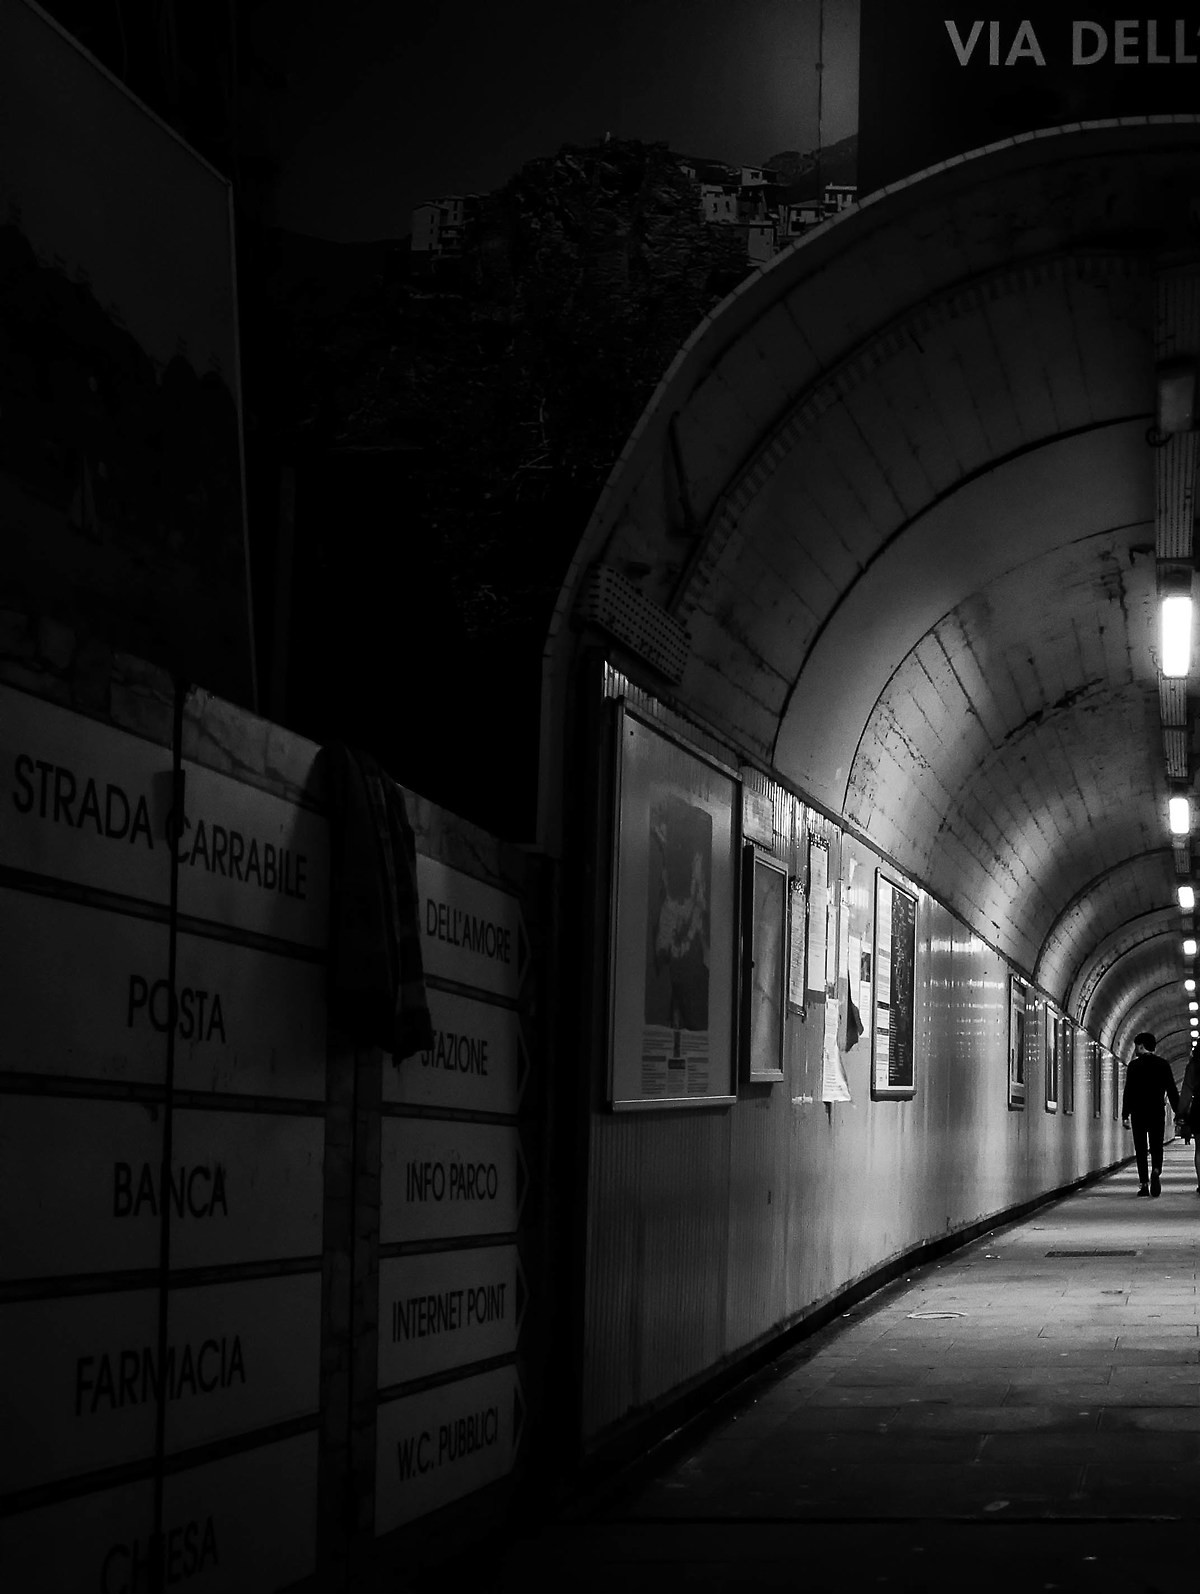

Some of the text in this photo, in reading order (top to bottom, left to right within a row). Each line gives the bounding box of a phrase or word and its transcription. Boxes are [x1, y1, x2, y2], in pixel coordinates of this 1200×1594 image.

[944, 19, 1047, 67] VIA
[12, 754, 308, 900] STRADA CARRABILE
[426, 899, 511, 964] DELL'AMORE
[127, 974, 226, 1043] POSTA
[113, 1161, 228, 1219] BANCA
[406, 1162, 498, 1202] INFO PARCO
[392, 1283, 507, 1343] INTERNET POINT
[74, 1335, 246, 1416] FARMACIA
[397, 1407, 499, 1482] W.C. PUBBLICI
